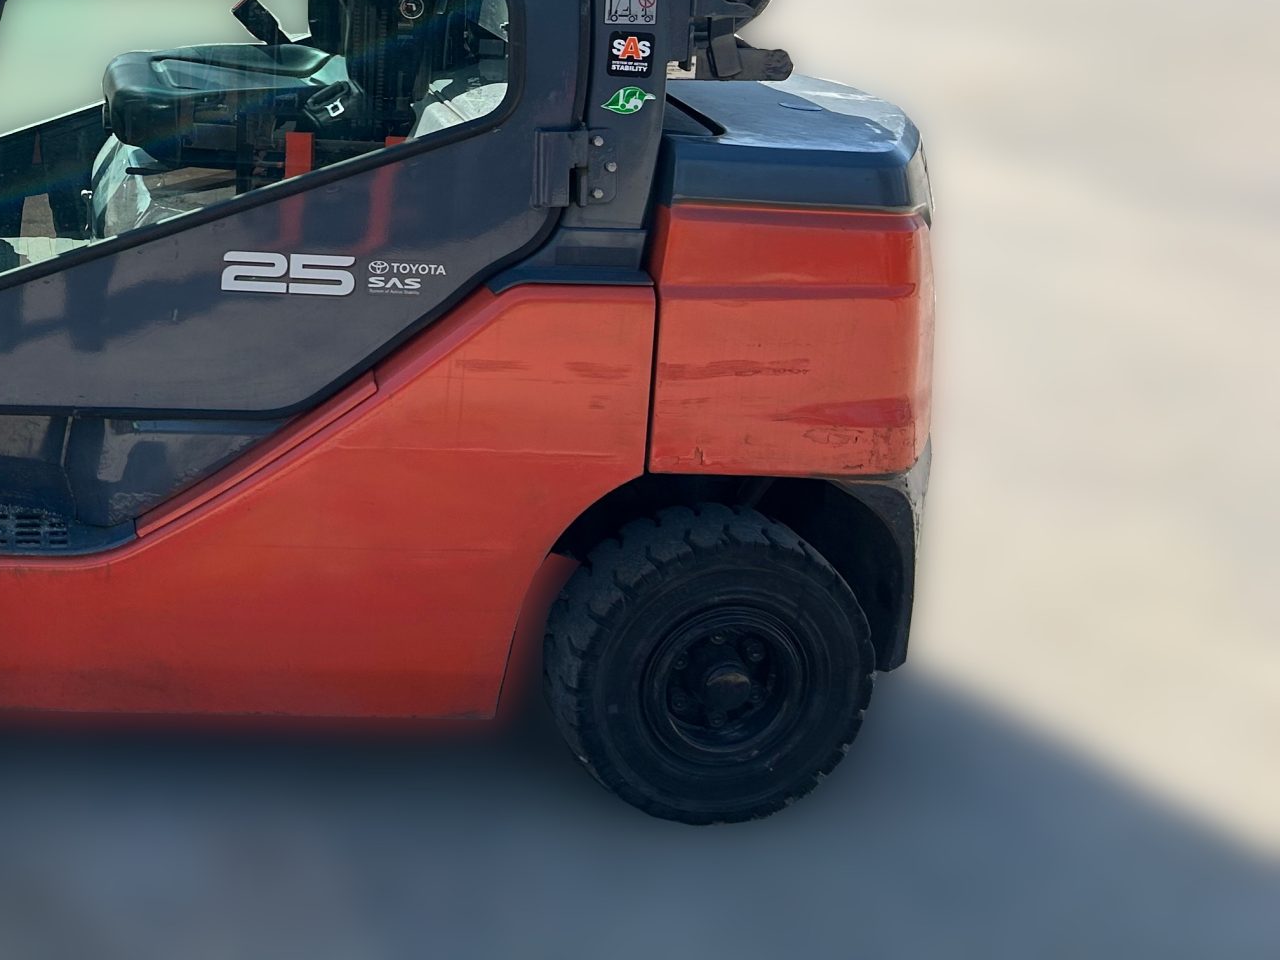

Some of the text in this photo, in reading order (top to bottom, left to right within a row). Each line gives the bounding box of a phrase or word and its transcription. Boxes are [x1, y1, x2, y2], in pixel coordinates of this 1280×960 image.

[612, 36, 651, 60] SAS
[611, 64, 648, 72] STABILITY
[221, 251, 446, 296] 25 TOYOTA
[368, 276, 422, 289] SAS
